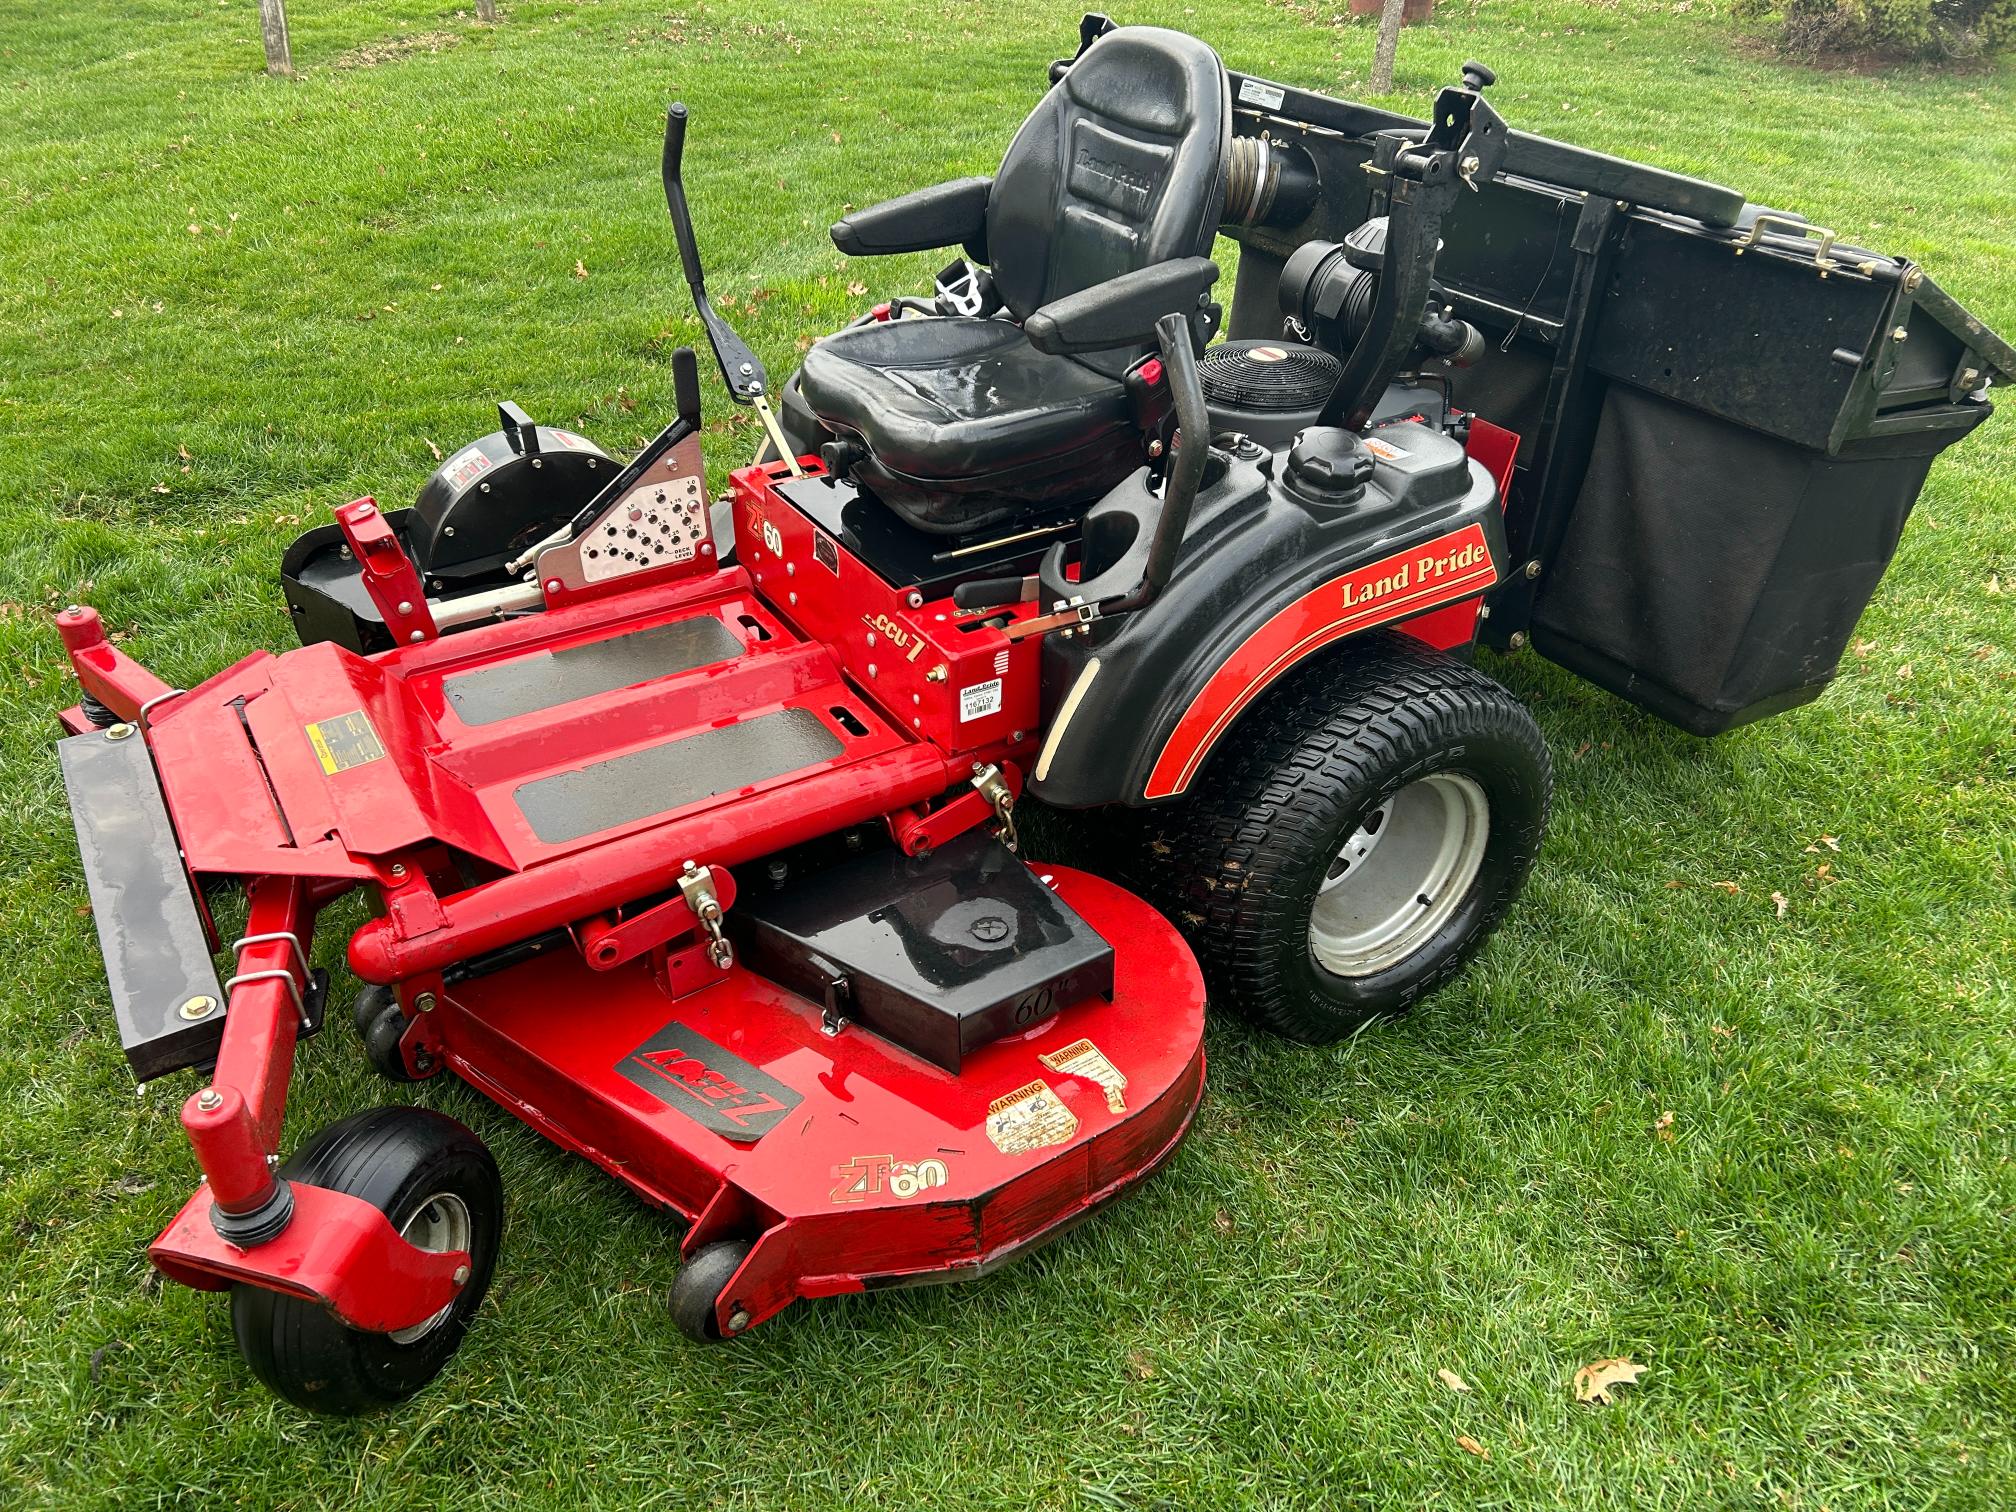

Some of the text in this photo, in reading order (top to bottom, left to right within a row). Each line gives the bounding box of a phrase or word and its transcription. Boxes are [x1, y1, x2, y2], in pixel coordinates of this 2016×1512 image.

[674, 551, 693, 559] LEVEL
[1341, 543, 1485, 609] Land Pride
[963, 685, 982, 696] Land
[982, 681, 1000, 690] Pride
[965, 696, 994, 710] 1167132
[1050, 1042, 1090, 1065] WARNING
[989, 1081, 1043, 1114] WARNING
